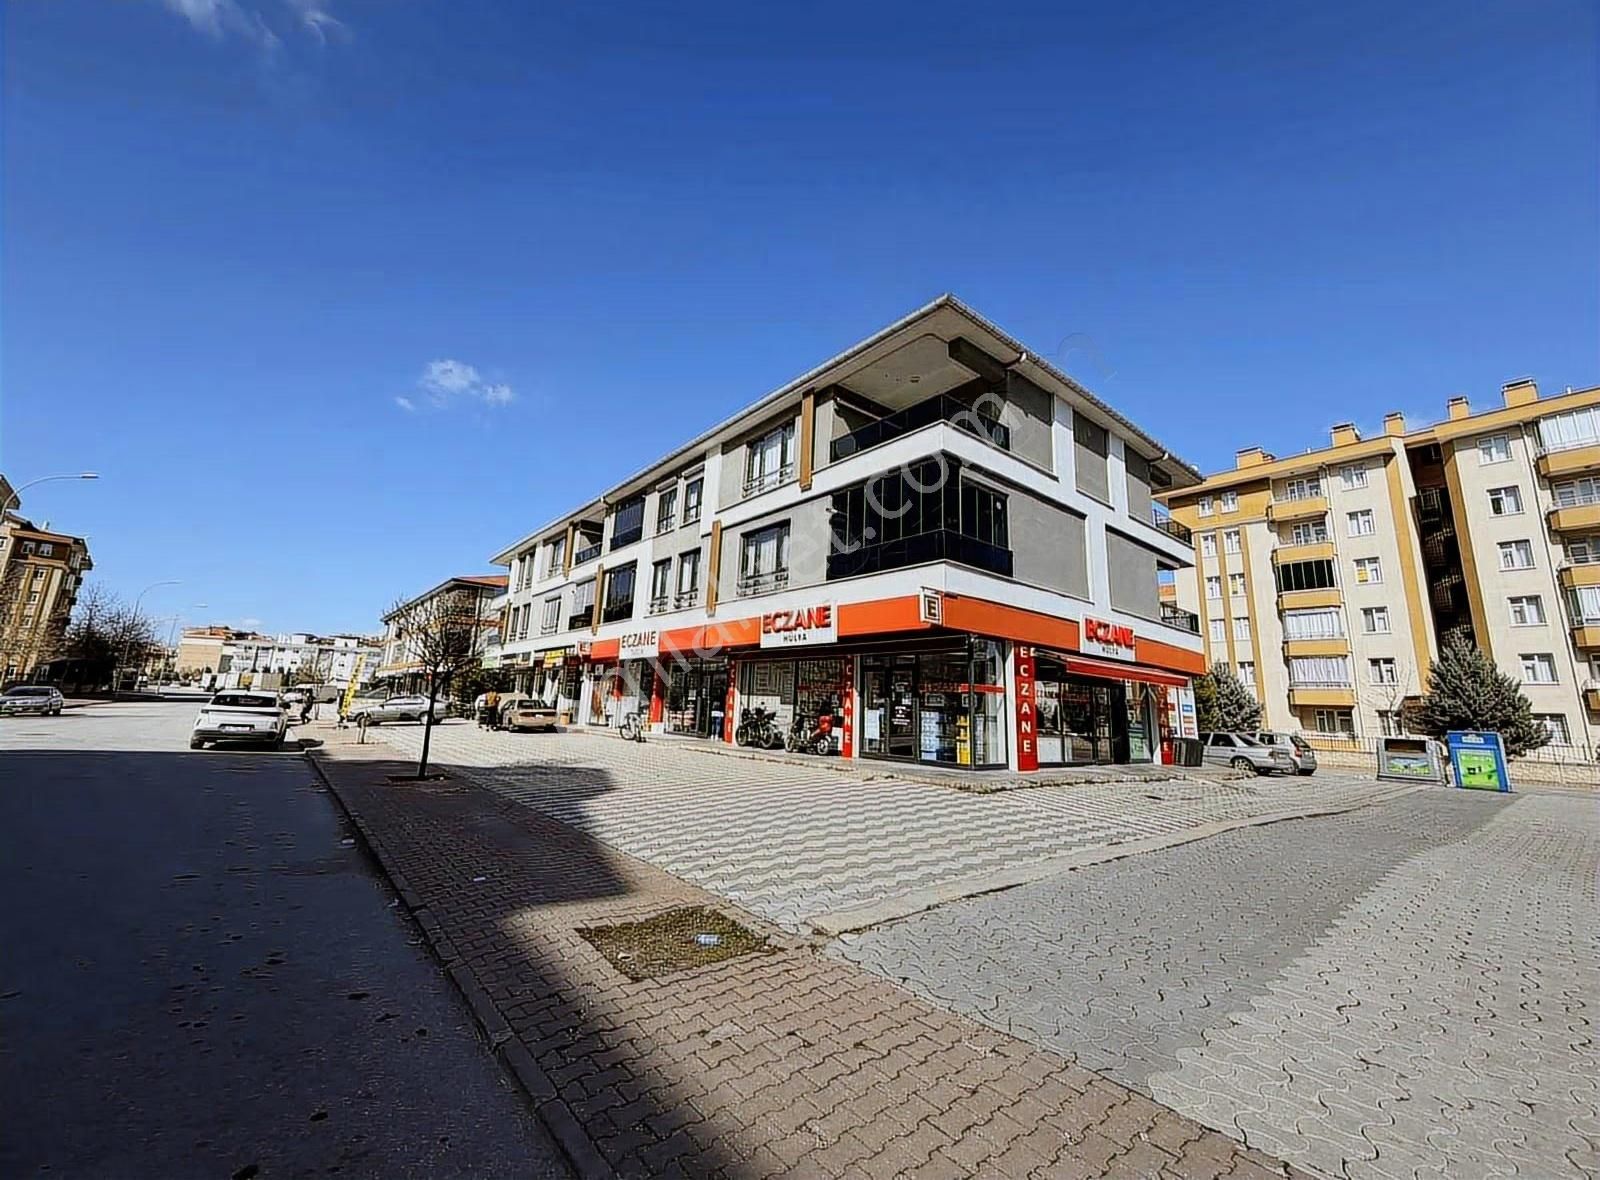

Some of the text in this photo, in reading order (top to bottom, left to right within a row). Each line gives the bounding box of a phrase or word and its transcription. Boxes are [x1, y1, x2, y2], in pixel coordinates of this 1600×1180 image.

[762, 604, 832, 634] ECZANE
[1085, 618, 1135, 650] ECZANE
[621, 630, 657, 649] ECZANE
[1019, 645, 1032, 753] ECZANE
[1158, 684, 1170, 752] CZANE
